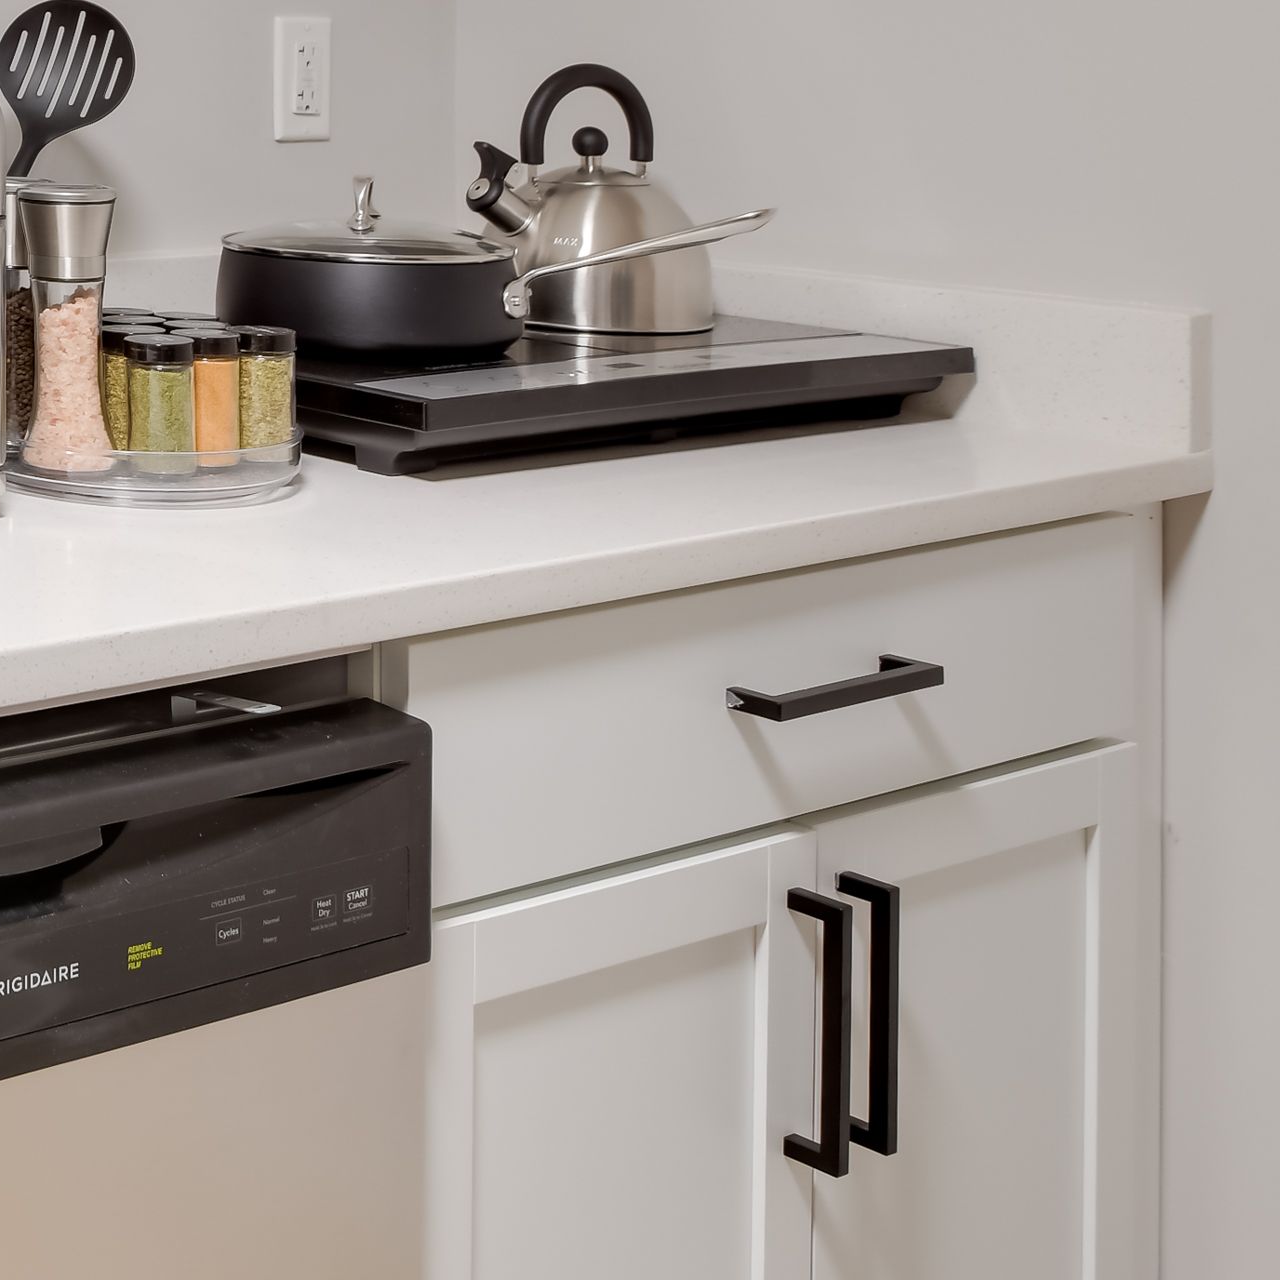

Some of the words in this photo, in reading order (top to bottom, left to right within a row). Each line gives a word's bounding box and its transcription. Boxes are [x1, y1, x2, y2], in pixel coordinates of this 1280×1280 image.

[346, 887, 369, 902] START
[210, 897, 227, 909] CYCLE
[228, 894, 246, 905] STATUS
[316, 899, 332, 909] Heat
[348, 899, 368, 910] Cancel
[318, 909, 330, 918] Dry
[218, 927, 239, 940] Cycles
[128, 941, 152, 954] REMOVE
[128, 947, 163, 962] PROTECTIVE
[128, 960, 142, 970] FILM
